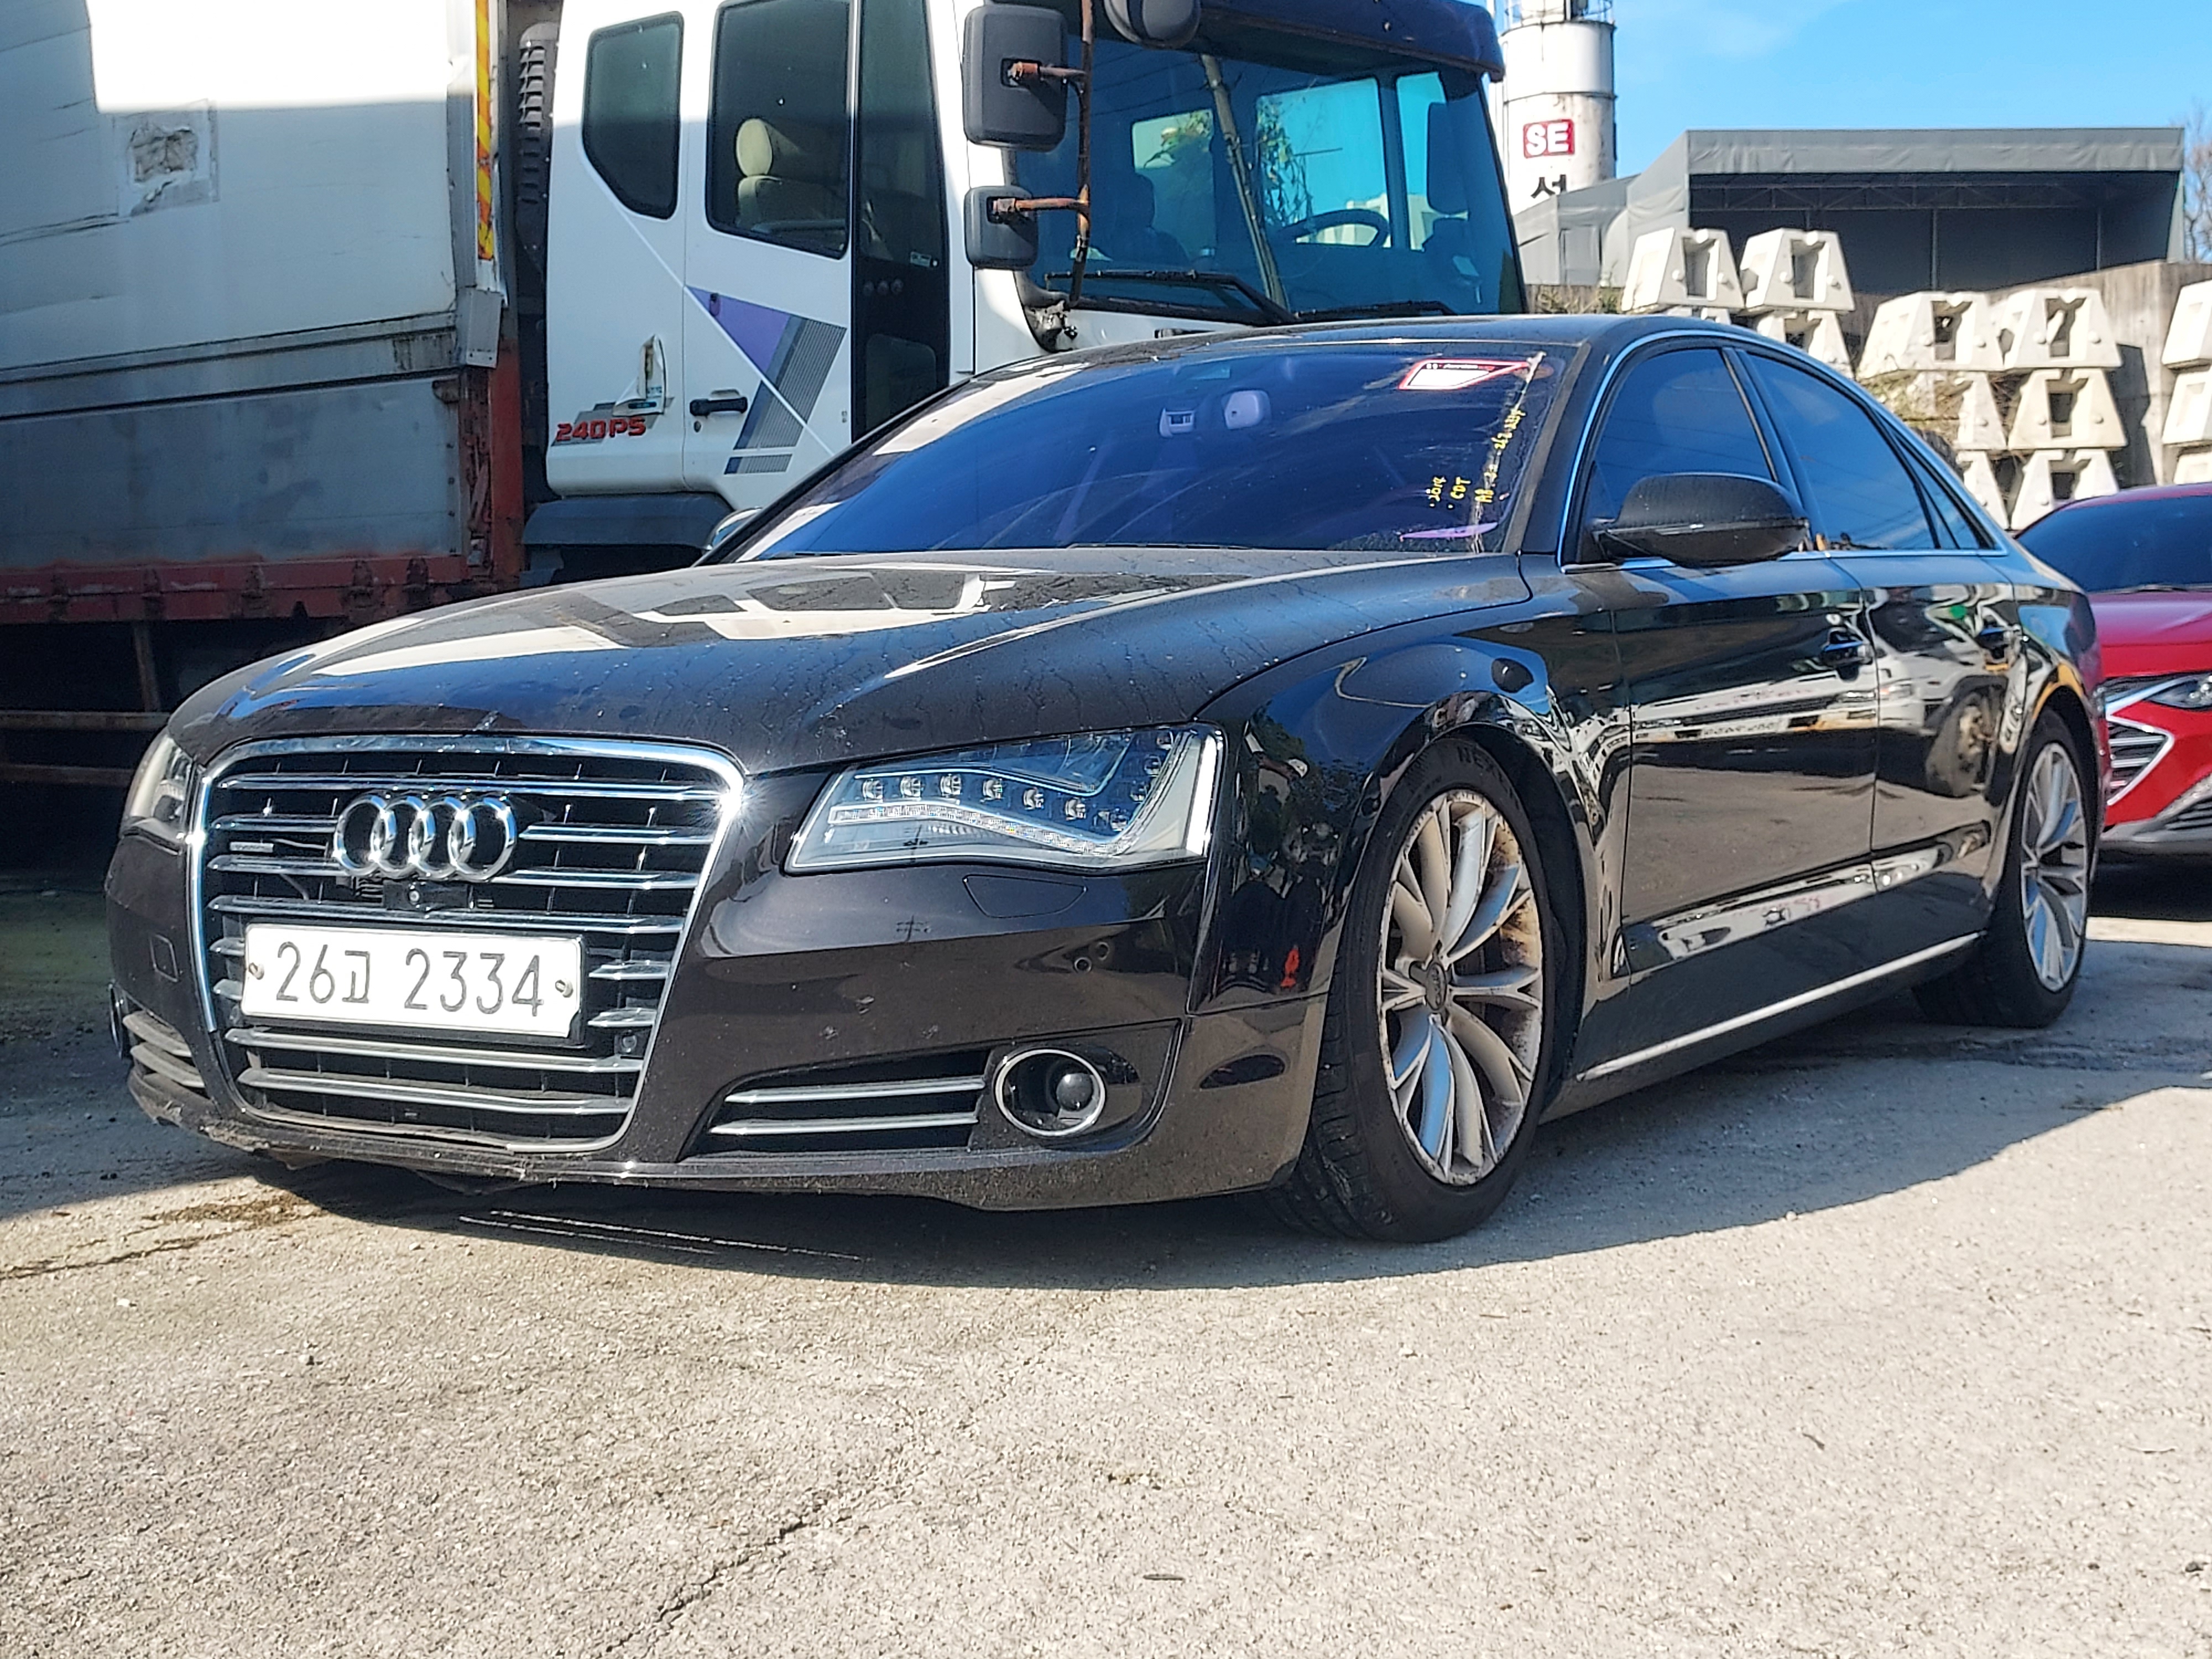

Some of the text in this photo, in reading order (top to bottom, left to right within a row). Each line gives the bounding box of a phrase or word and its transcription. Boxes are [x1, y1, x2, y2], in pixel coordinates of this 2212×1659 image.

[1525, 122, 1570, 156] SE
[555, 416, 646, 441] 240PS
[276, 941, 545, 1018] 26고 2334
